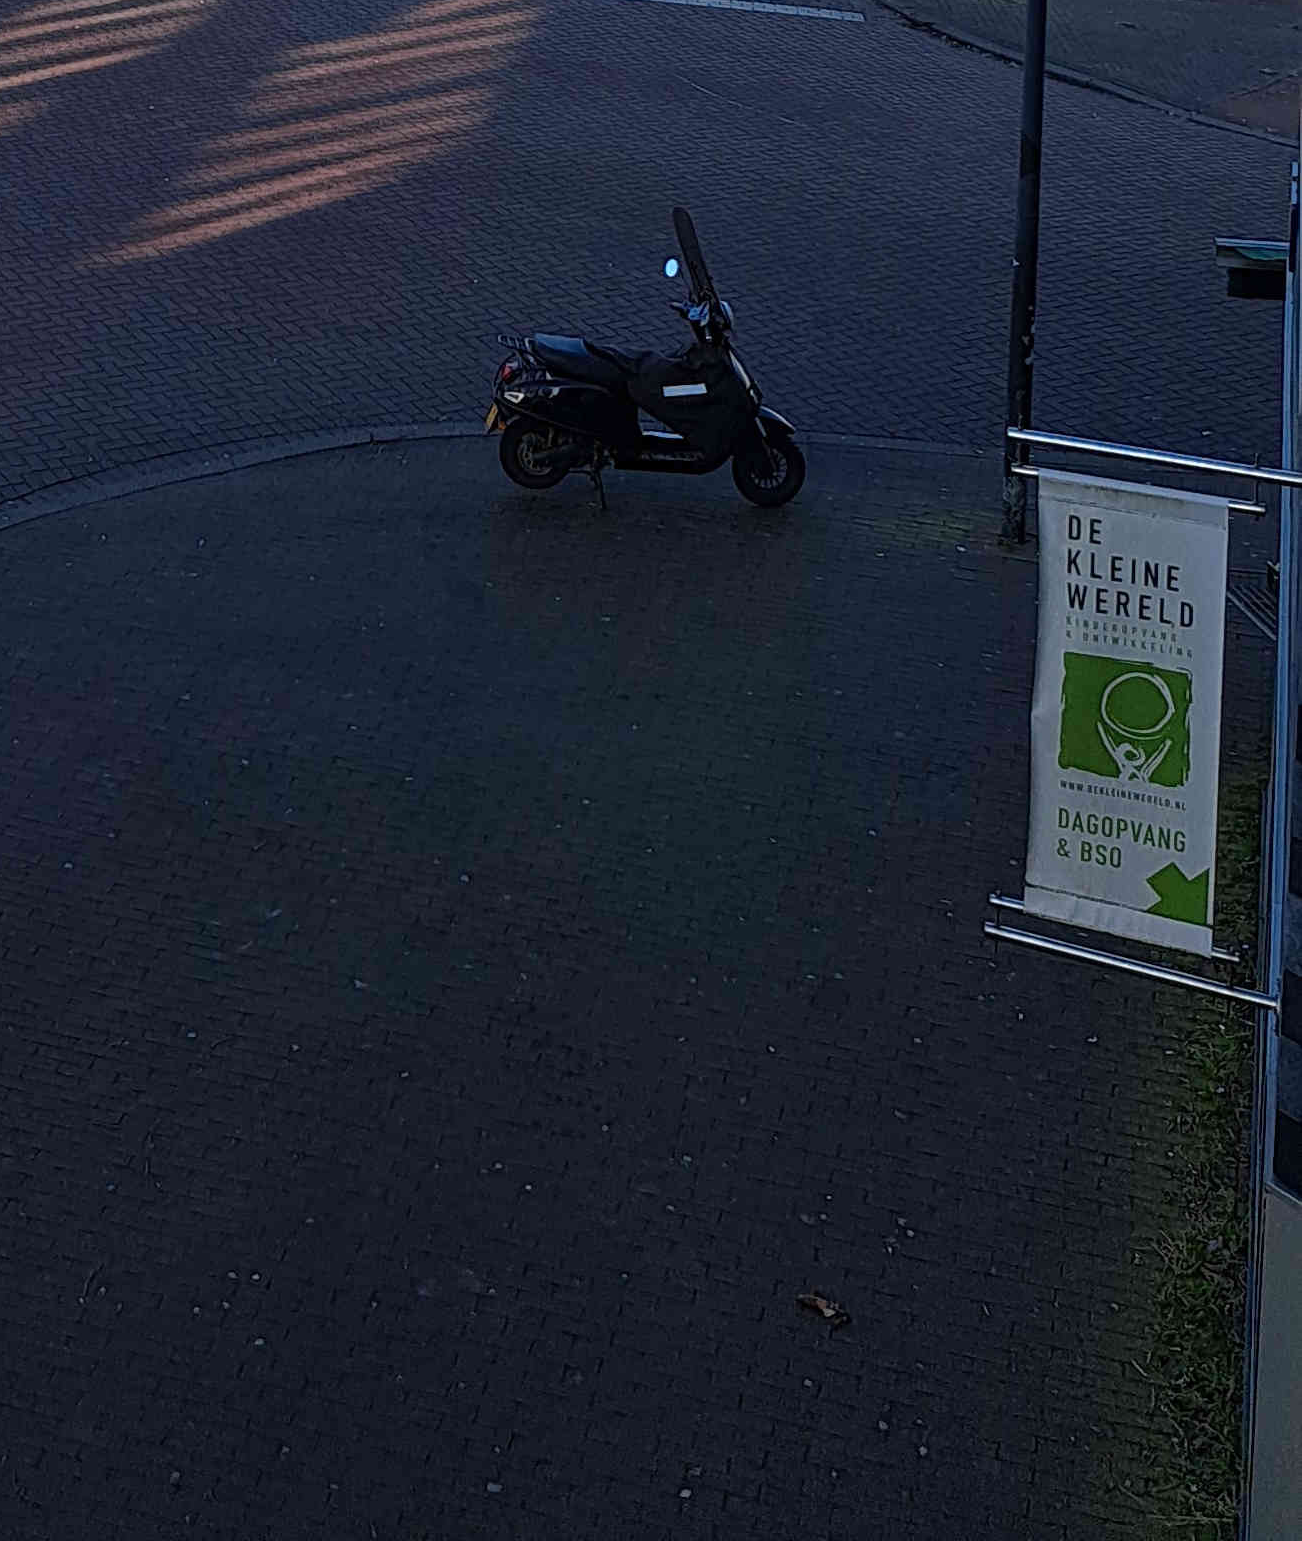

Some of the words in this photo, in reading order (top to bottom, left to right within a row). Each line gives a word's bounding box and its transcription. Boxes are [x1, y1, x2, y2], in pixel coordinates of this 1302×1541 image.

[1068, 514, 1102, 545] DE
[1066, 547, 1181, 593] KLEINE
[1066, 581, 1195, 628] WERELD
[1066, 616, 1178, 643] KINDEROPVANG
[1057, 807, 1187, 853] DAGOPVANG
[1057, 838, 1071, 858] &
[1080, 840, 1122, 869] BSO
